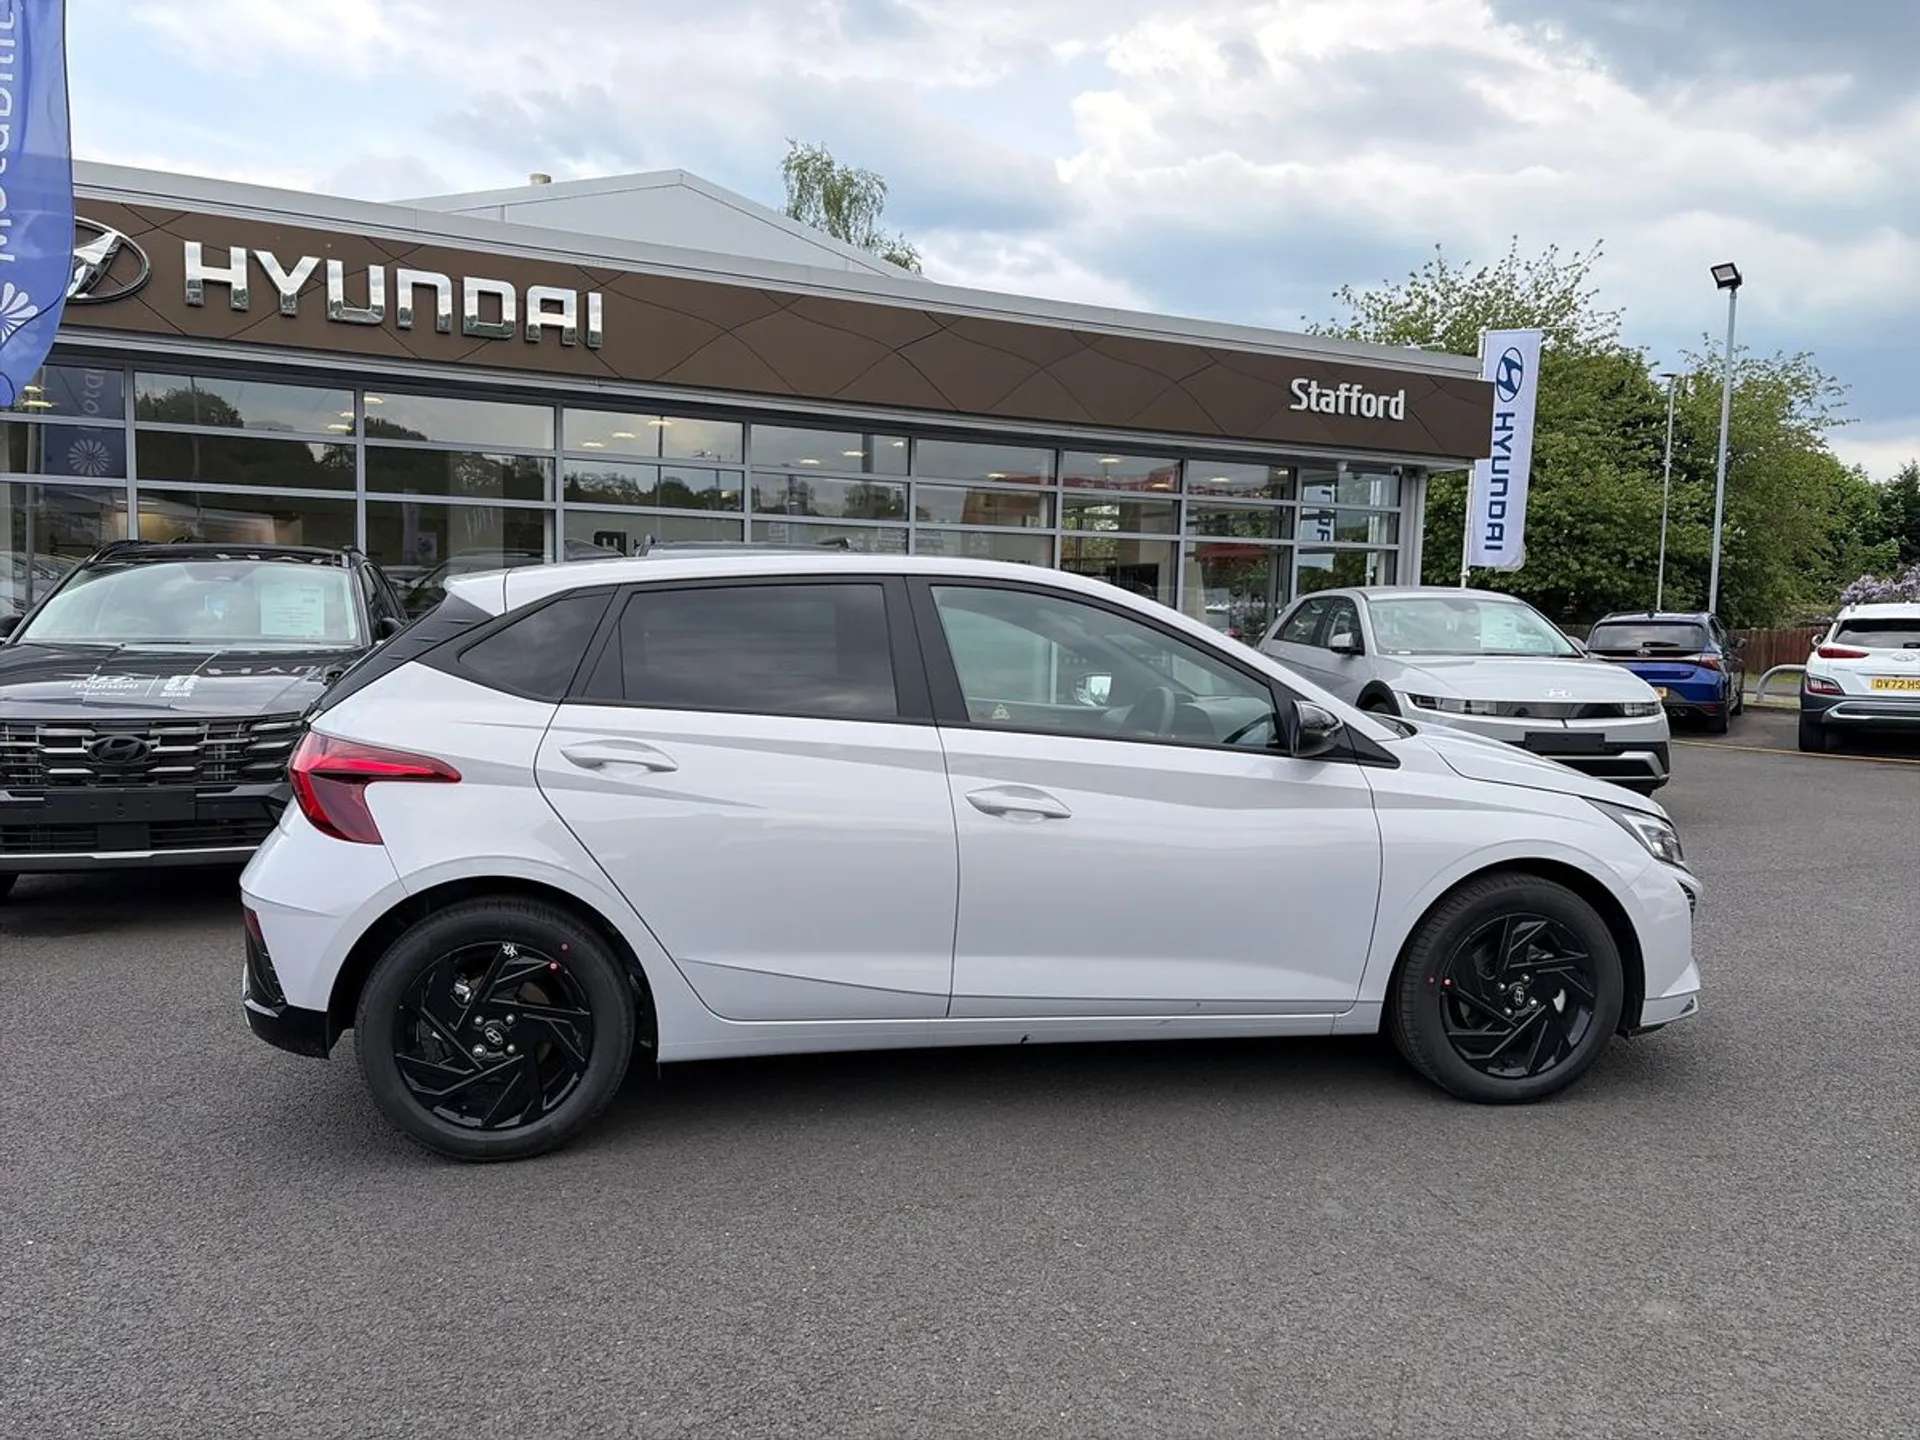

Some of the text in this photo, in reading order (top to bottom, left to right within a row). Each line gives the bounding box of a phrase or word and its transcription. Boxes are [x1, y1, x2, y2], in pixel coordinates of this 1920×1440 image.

[184, 241, 603, 349] HYUNDAI
[1290, 377, 1405, 420] Stafford
[1484, 412, 1515, 550] HYUNDAI
